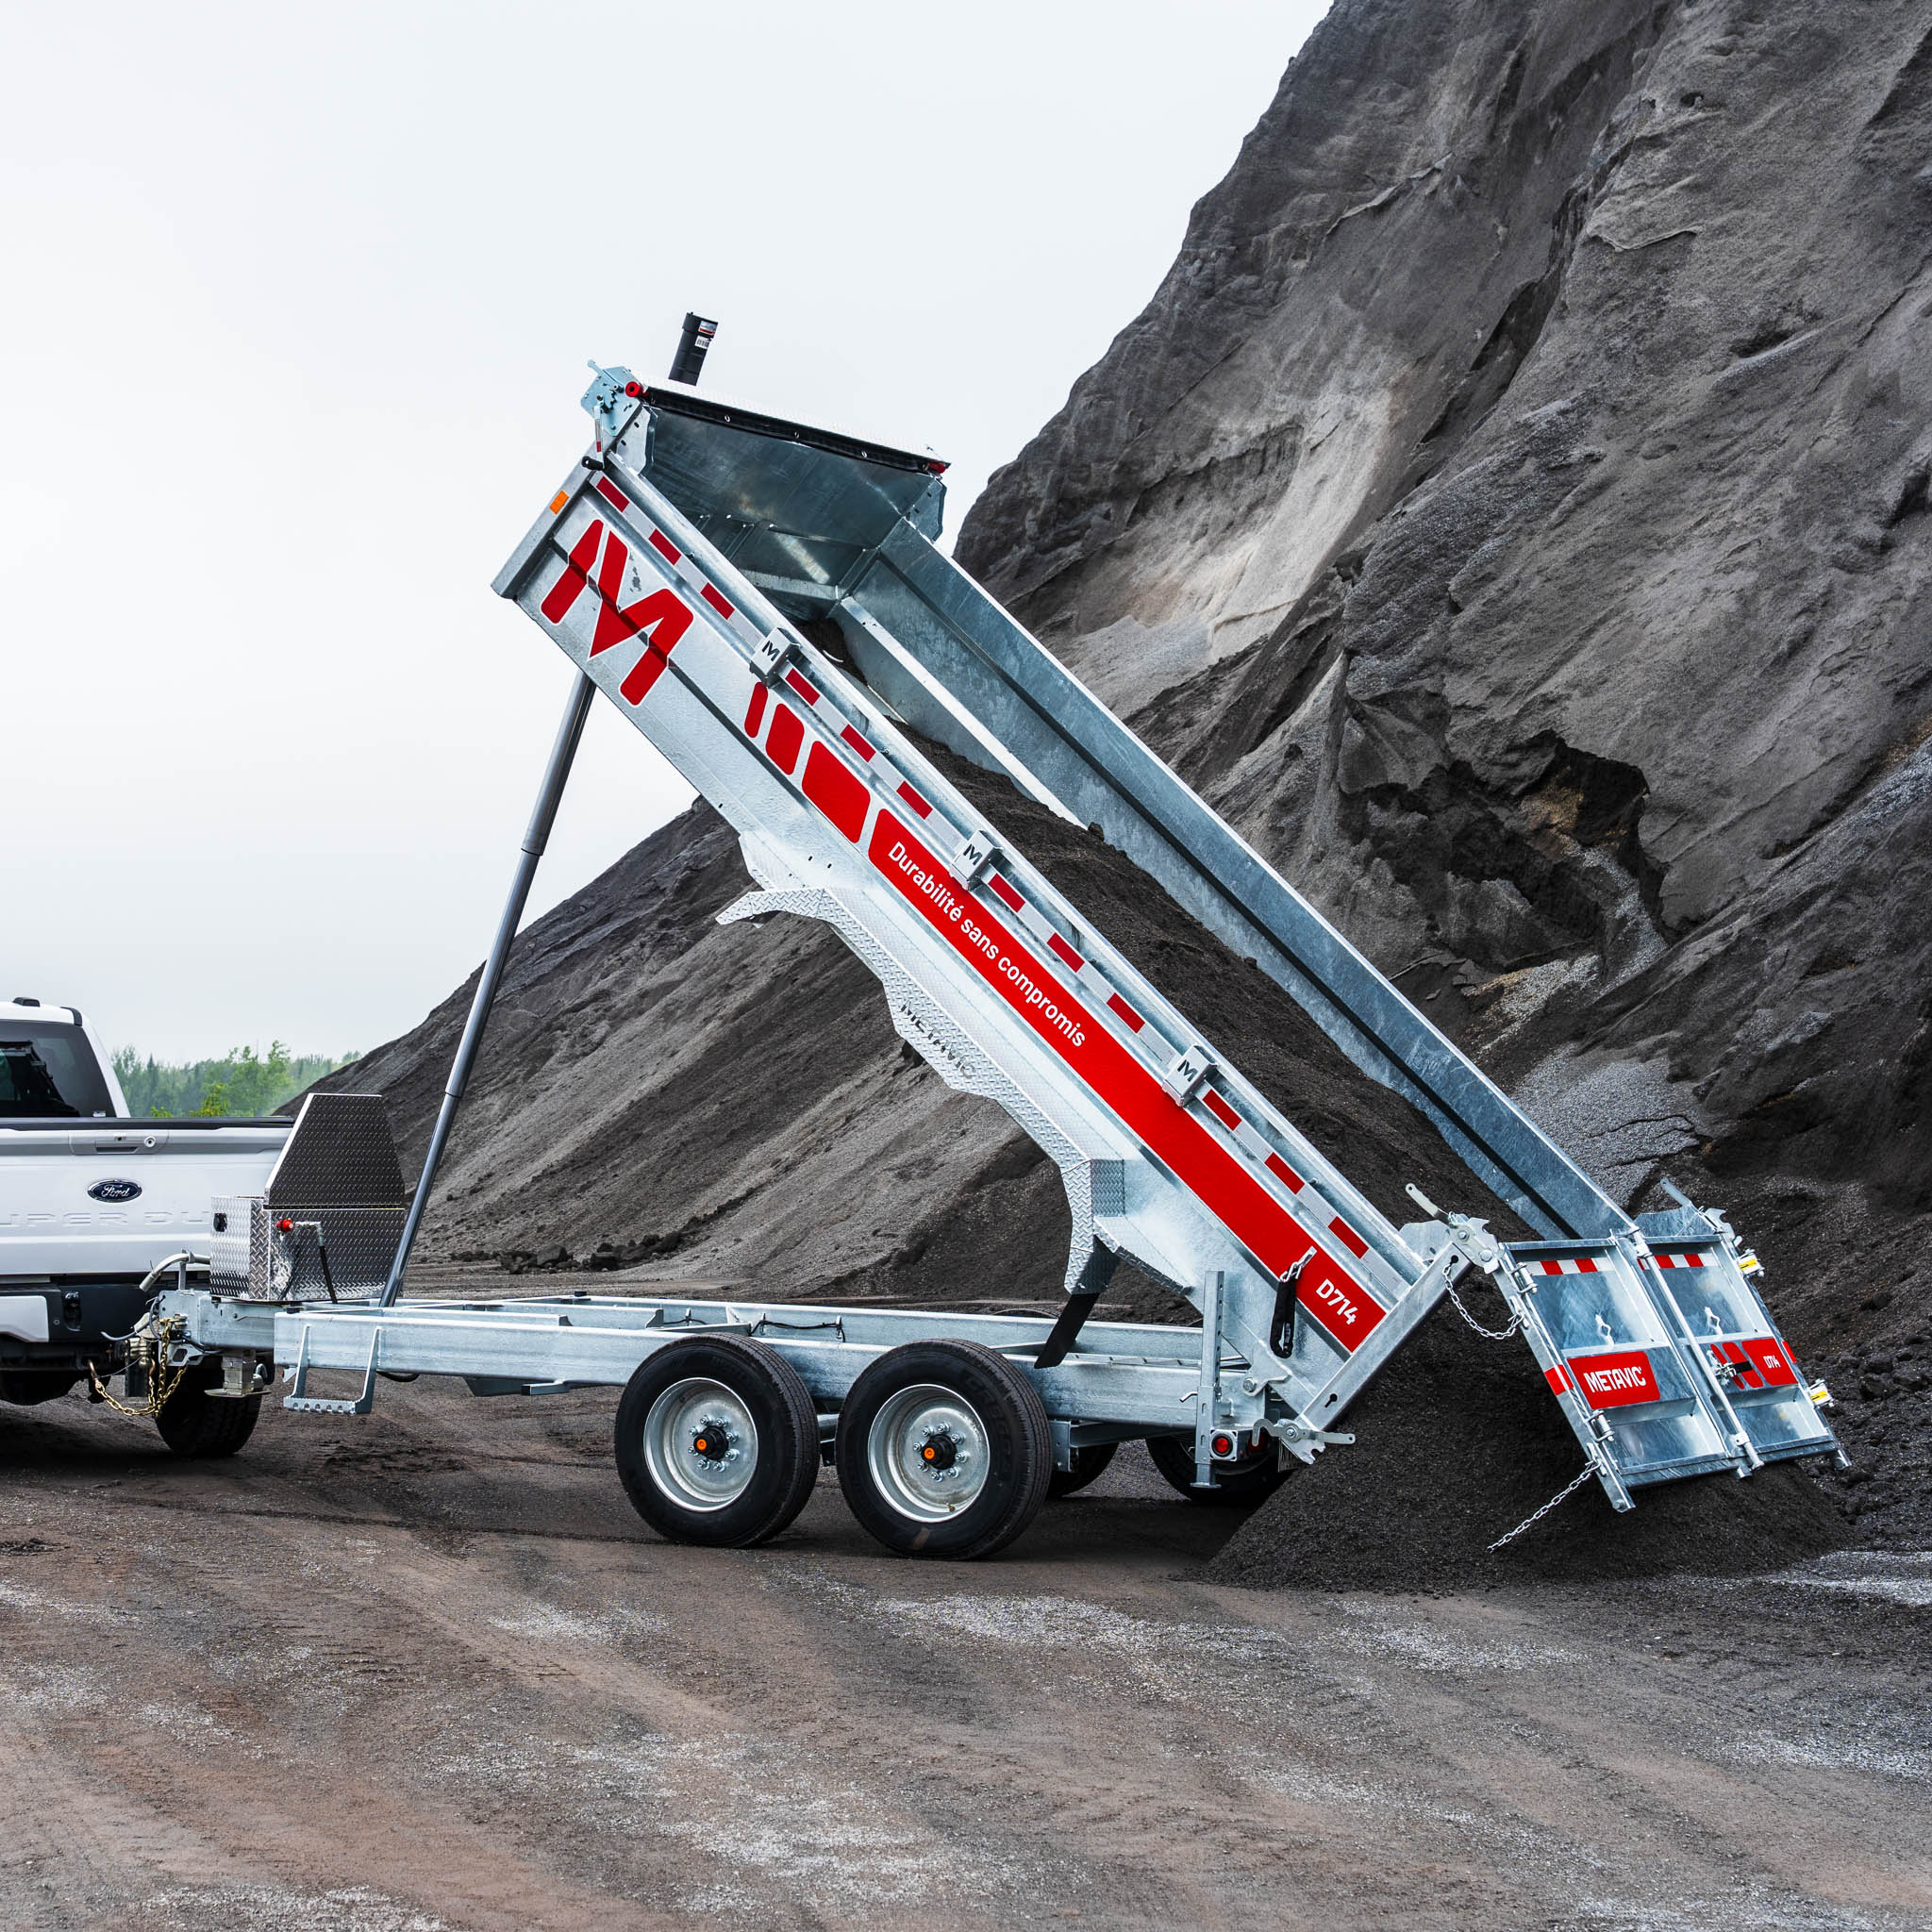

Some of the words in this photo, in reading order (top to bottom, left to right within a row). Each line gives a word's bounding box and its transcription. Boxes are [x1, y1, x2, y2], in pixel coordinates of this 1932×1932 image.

[541, 519, 694, 707] M
[761, 641, 781, 662] M
[963, 843, 983, 866] M
[888, 841, 965, 922] Durabilité
[960, 919, 1000, 960] sans
[998, 957, 1086, 1047] compromis
[1176, 1059, 1198, 1083] M
[101, 1184, 130, 1198] Ford
[1316, 1278, 1358, 1325] D714
[1583, 1365, 1647, 1393] METAVIC
